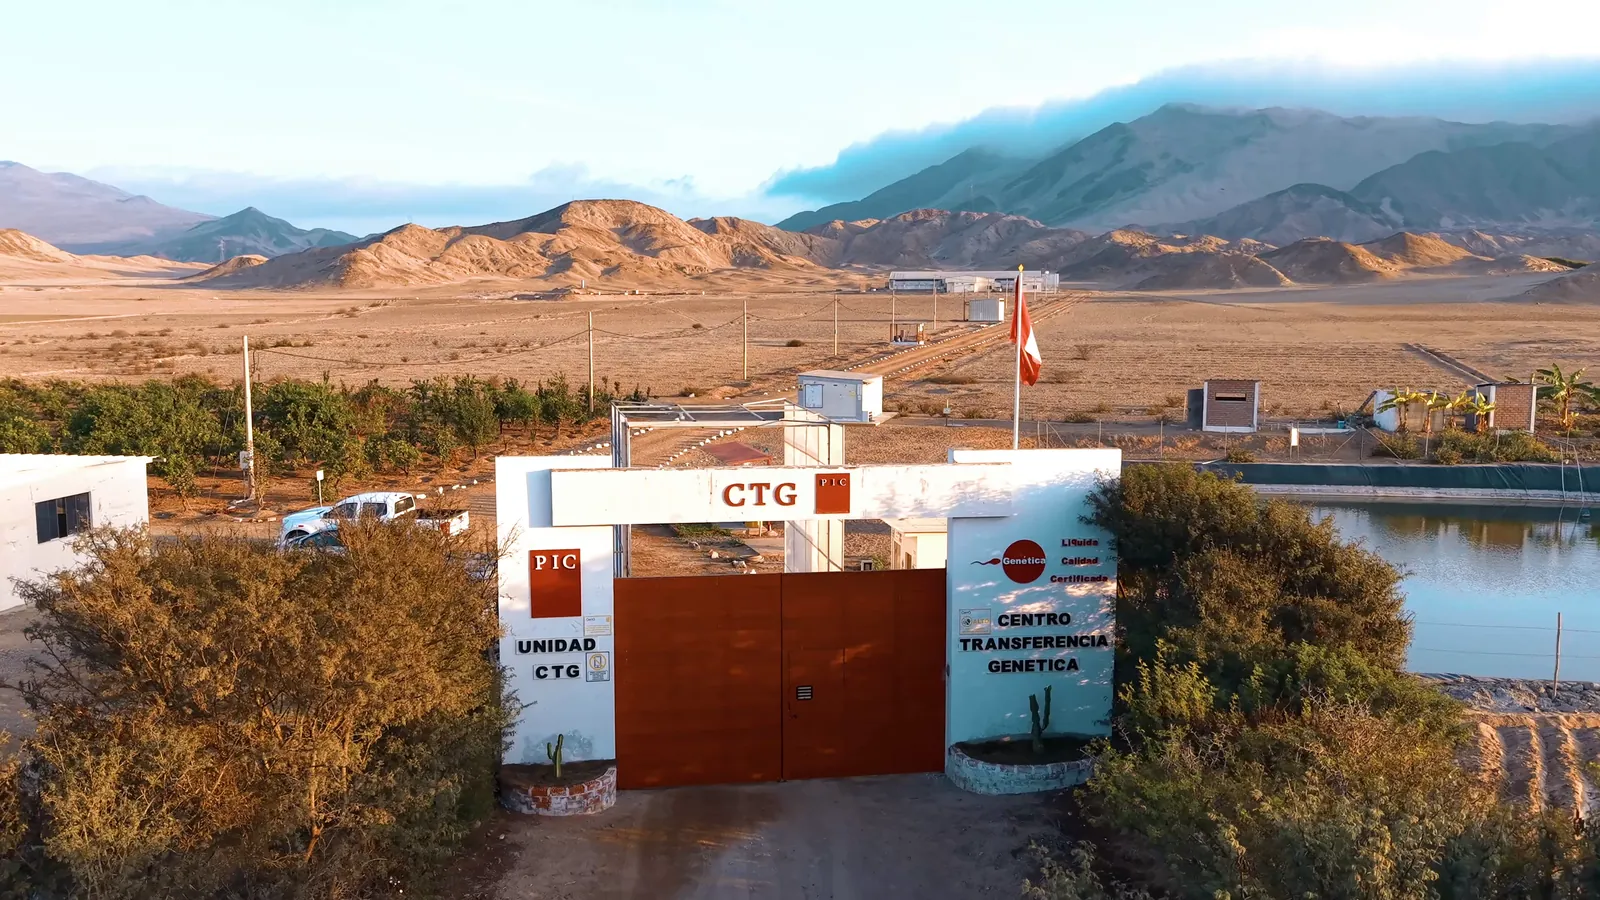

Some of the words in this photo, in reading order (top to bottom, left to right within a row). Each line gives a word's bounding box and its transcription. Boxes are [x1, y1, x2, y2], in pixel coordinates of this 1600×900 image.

[821, 478, 847, 486] PIC
[722, 483, 797, 507] CTG
[534, 554, 577, 570] PIC
[1002, 556, 1046, 565] Genética
[1061, 557, 1098, 565] Calidad
[1050, 575, 1108, 583] Certificada
[998, 613, 1071, 627] CENTRO
[518, 638, 596, 653] UNIDAD
[960, 635, 1108, 650] TRANSFERENCIA
[535, 665, 580, 679] CTG
[988, 659, 1079, 673] GENETICA
